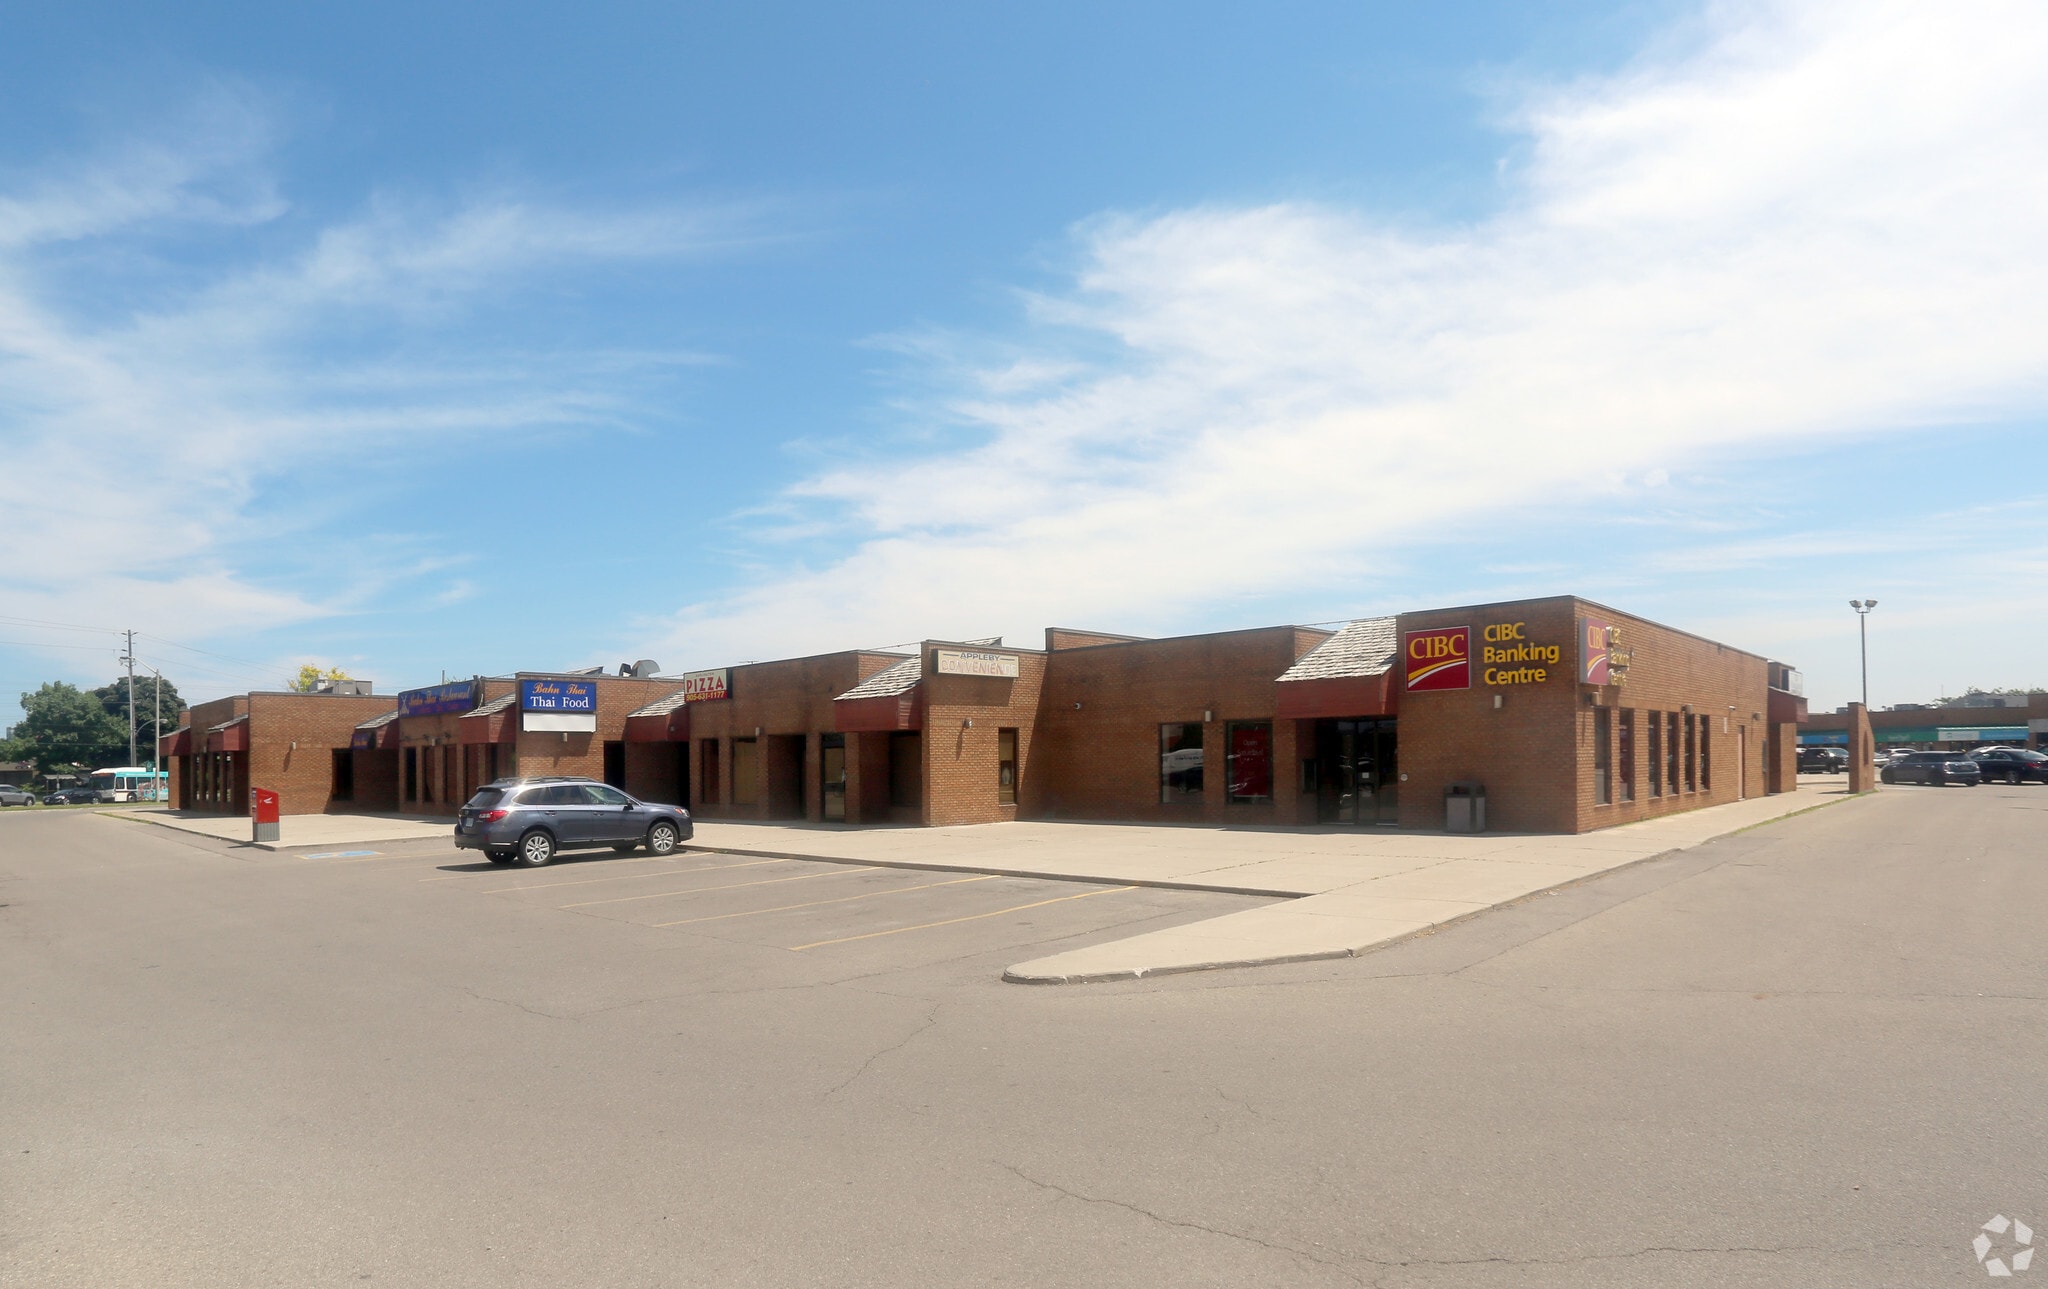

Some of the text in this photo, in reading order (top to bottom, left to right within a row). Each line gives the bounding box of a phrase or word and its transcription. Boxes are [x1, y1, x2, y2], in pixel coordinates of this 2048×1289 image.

[1483, 622, 1525, 642] CIBC
[1588, 626, 1606, 651] CIBC
[1409, 634, 1465, 660] CIBC
[1483, 642, 1559, 664] Banking
[960, 653, 1001, 662] APPLEBY
[686, 676, 724, 693] PIZZA
[1484, 666, 1547, 685] Centre
[532, 682, 588, 695] Bahn Thai
[686, 691, 725, 701] 905-631-1177
[530, 696, 589, 708] Thai Food
